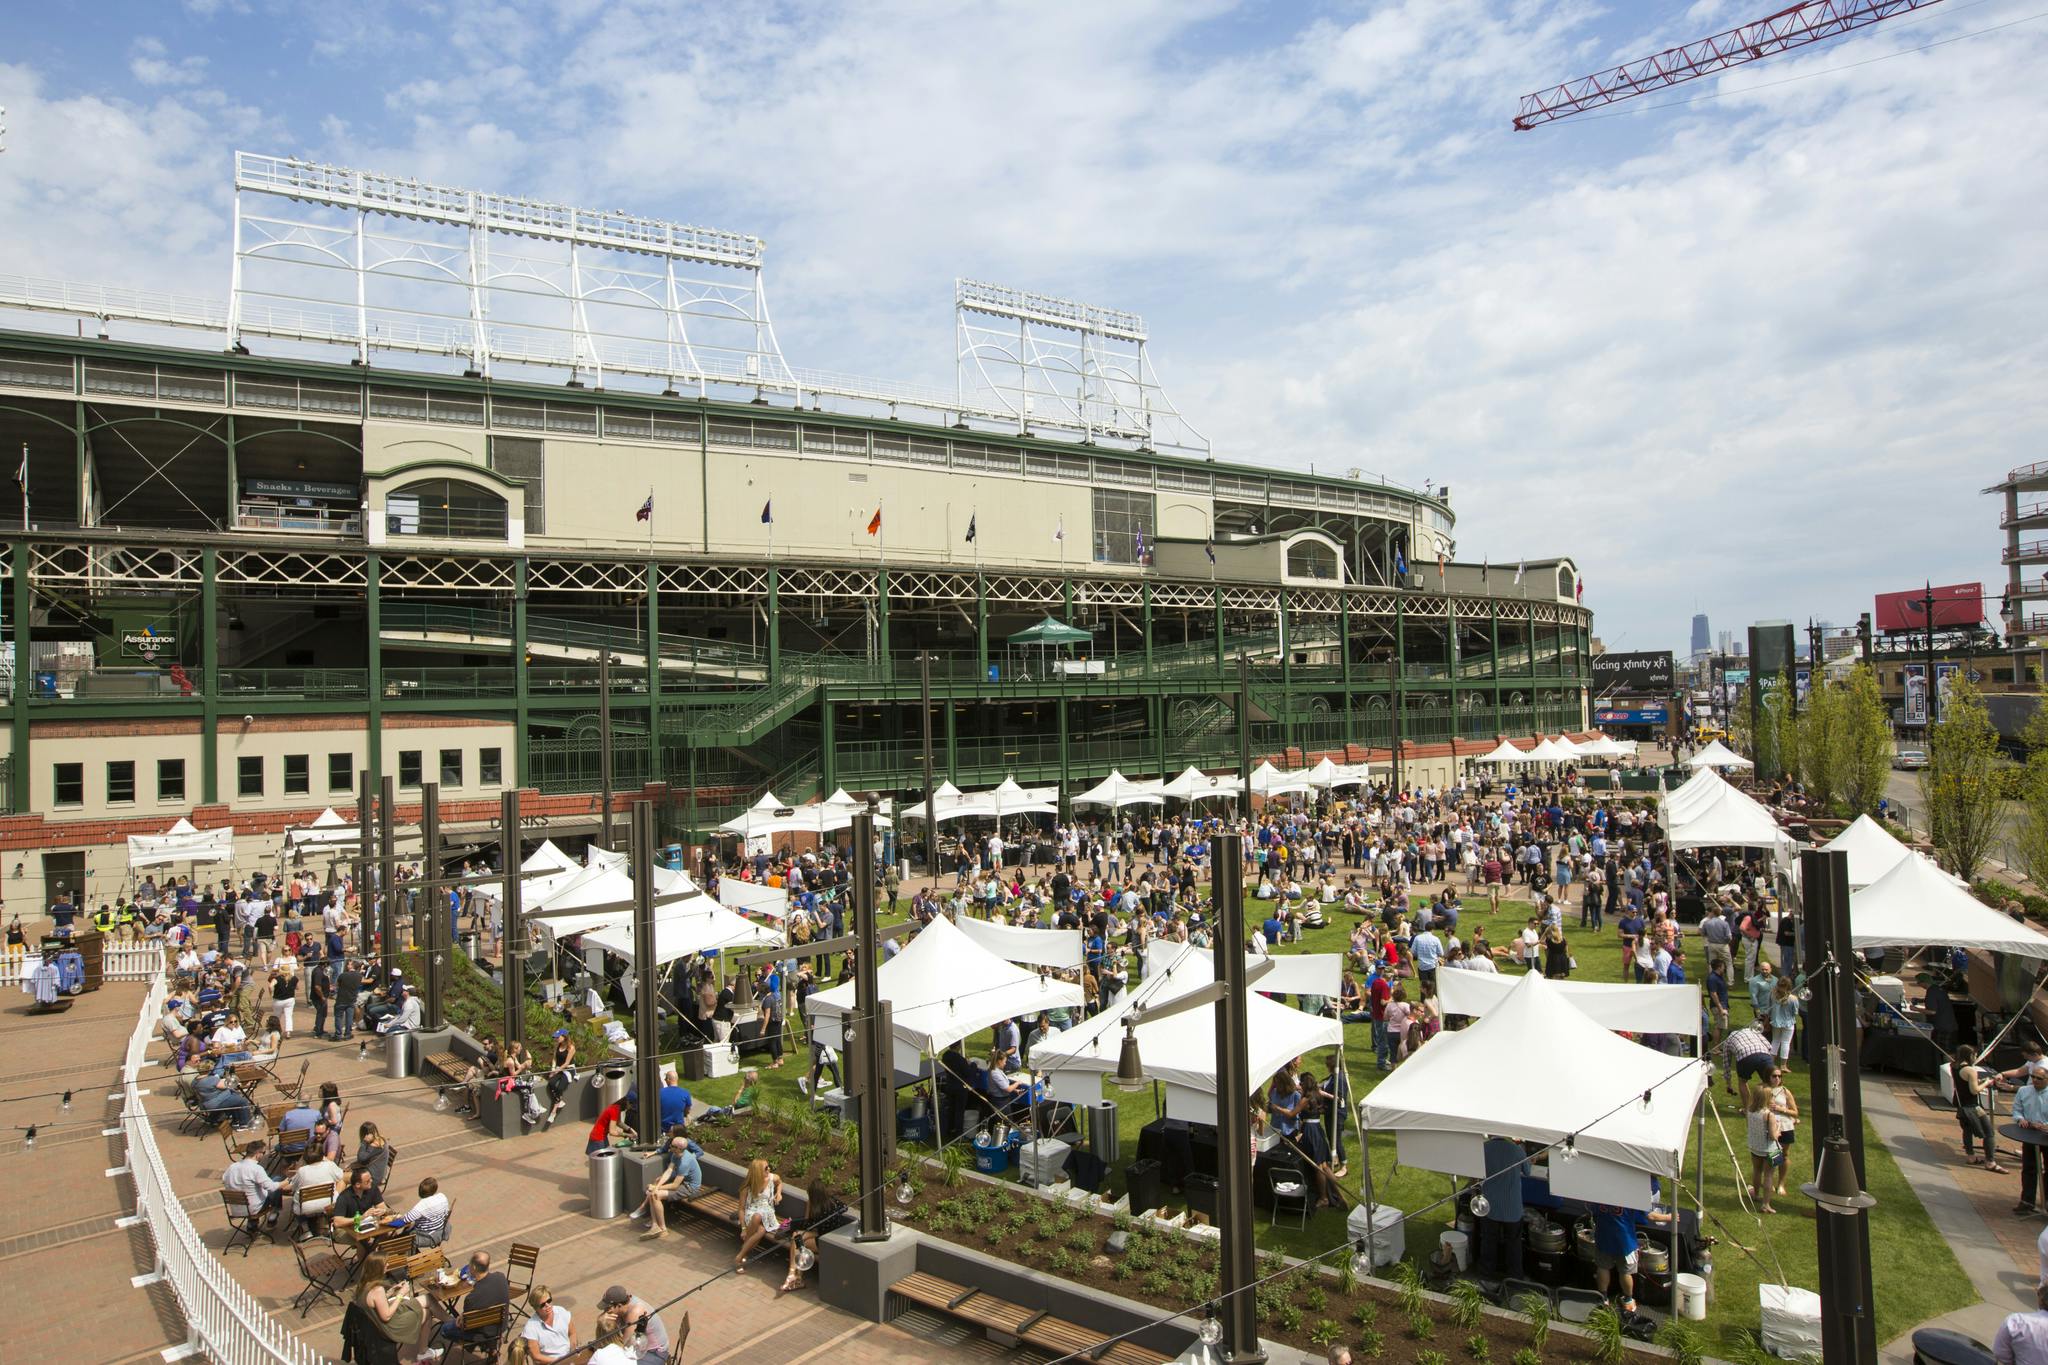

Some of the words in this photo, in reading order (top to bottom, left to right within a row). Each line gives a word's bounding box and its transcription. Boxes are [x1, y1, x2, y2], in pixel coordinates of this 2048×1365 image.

[256, 482, 292, 491] Snacks
[304, 484, 351, 495] Beverages
[124, 635, 175, 643] Assurance
[139, 642, 161, 650] Club
[1623, 659, 1651, 670] xfinity
[490, 814, 549, 829] DNKS
